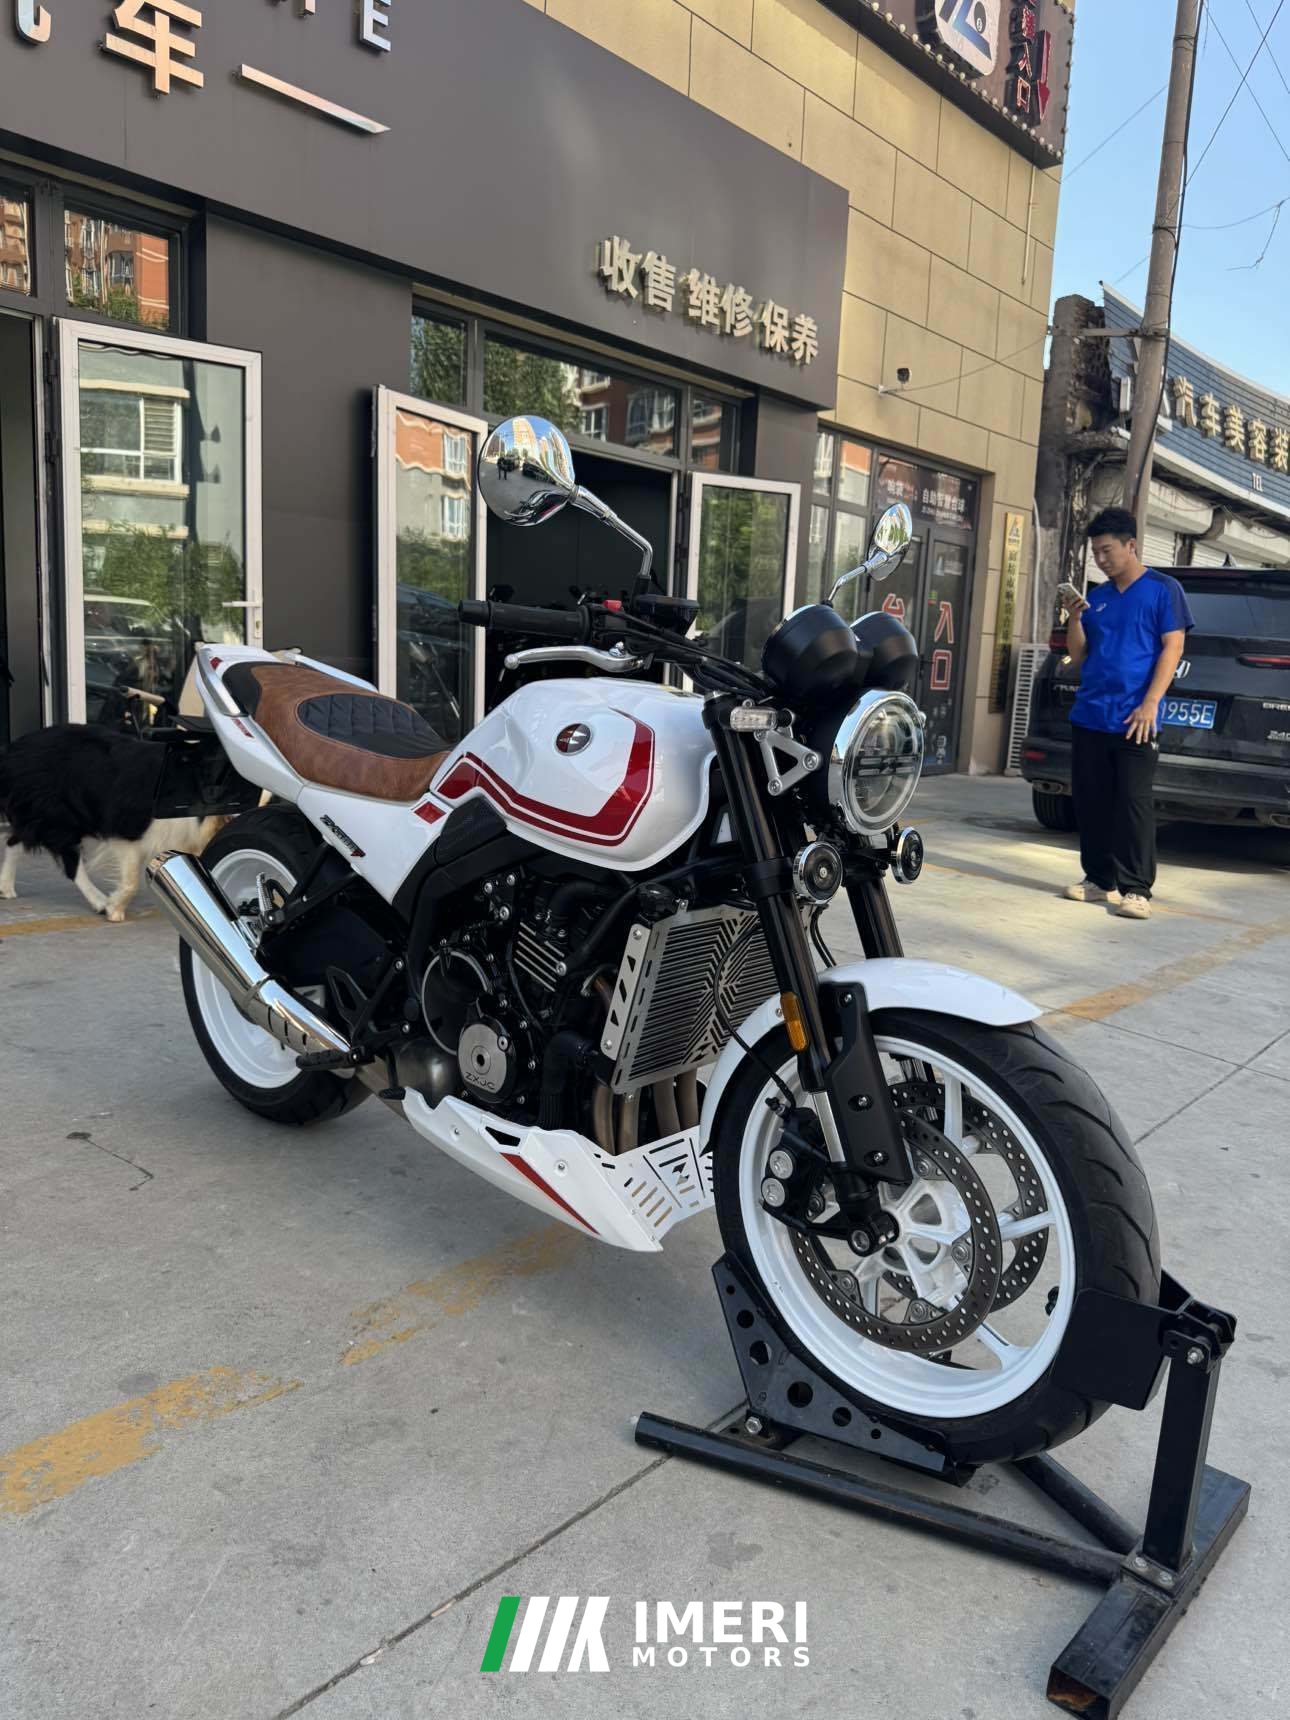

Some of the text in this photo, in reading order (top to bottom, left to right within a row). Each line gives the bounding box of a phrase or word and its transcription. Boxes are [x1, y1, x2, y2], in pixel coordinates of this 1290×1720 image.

[600, 235, 818, 365] 收售 维修 保养
[930, 601, 954, 691] 入口
